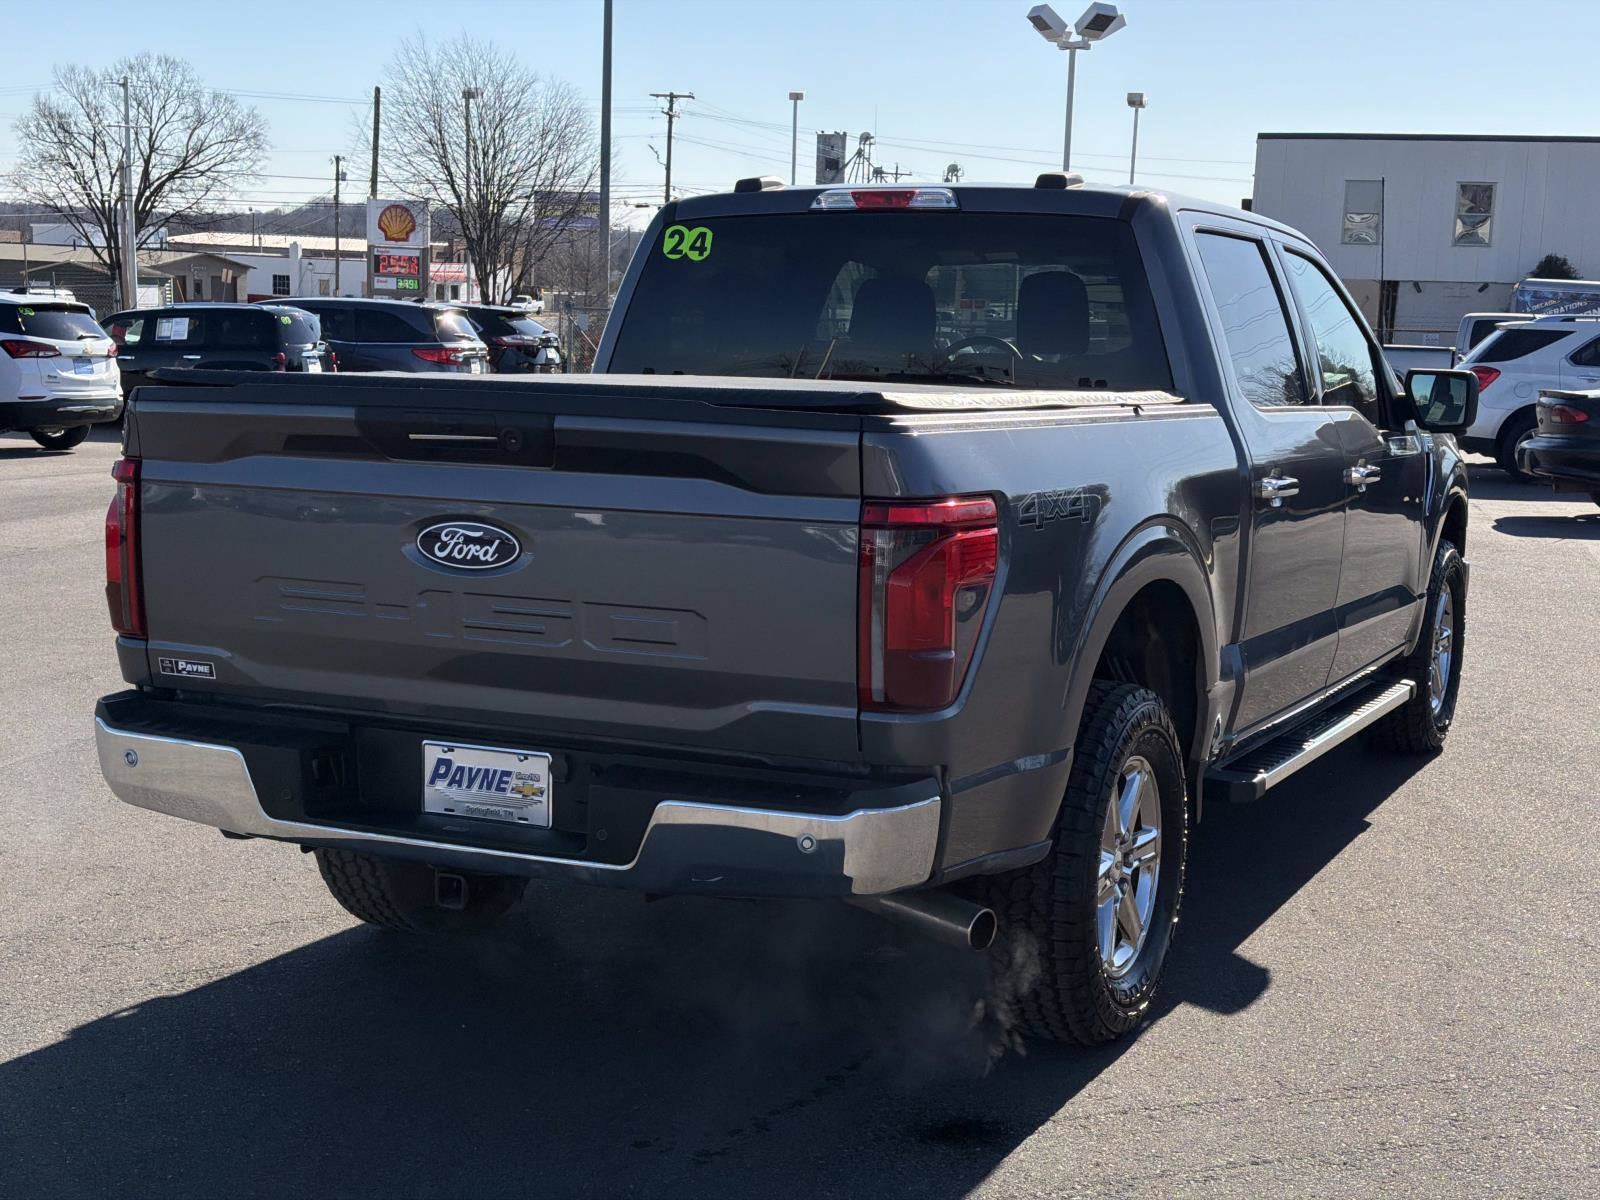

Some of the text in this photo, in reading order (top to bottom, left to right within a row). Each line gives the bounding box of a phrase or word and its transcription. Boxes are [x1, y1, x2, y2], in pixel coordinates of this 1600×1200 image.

[665, 228, 708, 257] 24
[434, 527, 500, 562] Ford
[253, 576, 708, 660] F-150
[428, 757, 514, 793] PAYNE
